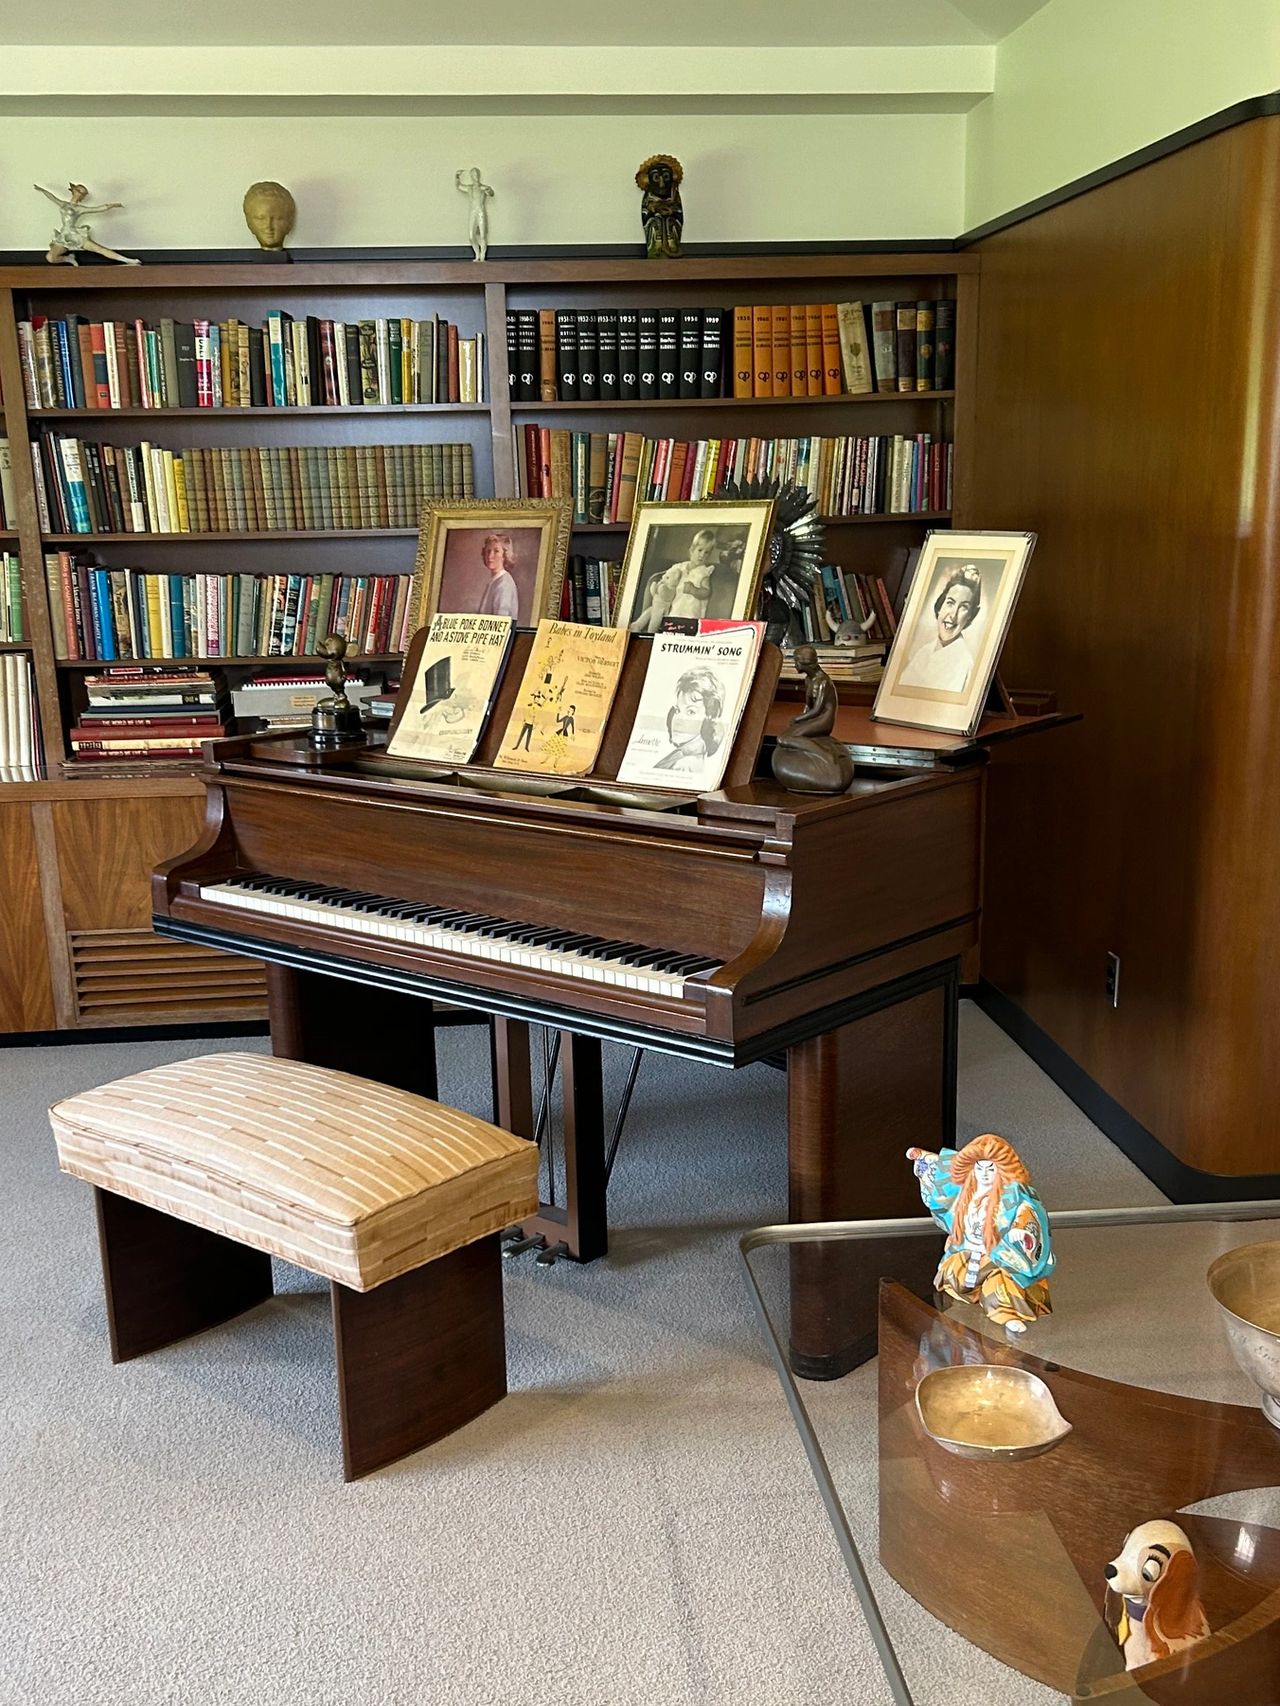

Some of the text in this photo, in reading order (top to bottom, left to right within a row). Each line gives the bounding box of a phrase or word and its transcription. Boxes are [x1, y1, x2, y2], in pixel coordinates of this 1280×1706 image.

[442, 618, 458, 629] BLUE
[460, 618, 477, 631] POKE
[478, 619, 509, 632] BONNET
[549, 622, 618, 643] Babes in Toyland
[430, 631, 443, 642] AND
[448, 631, 470, 644] STOVE
[471, 632, 489, 645] PIPE
[488, 634, 505, 647] HAT
[661, 643, 742, 656] STRUMMIN' SONG
